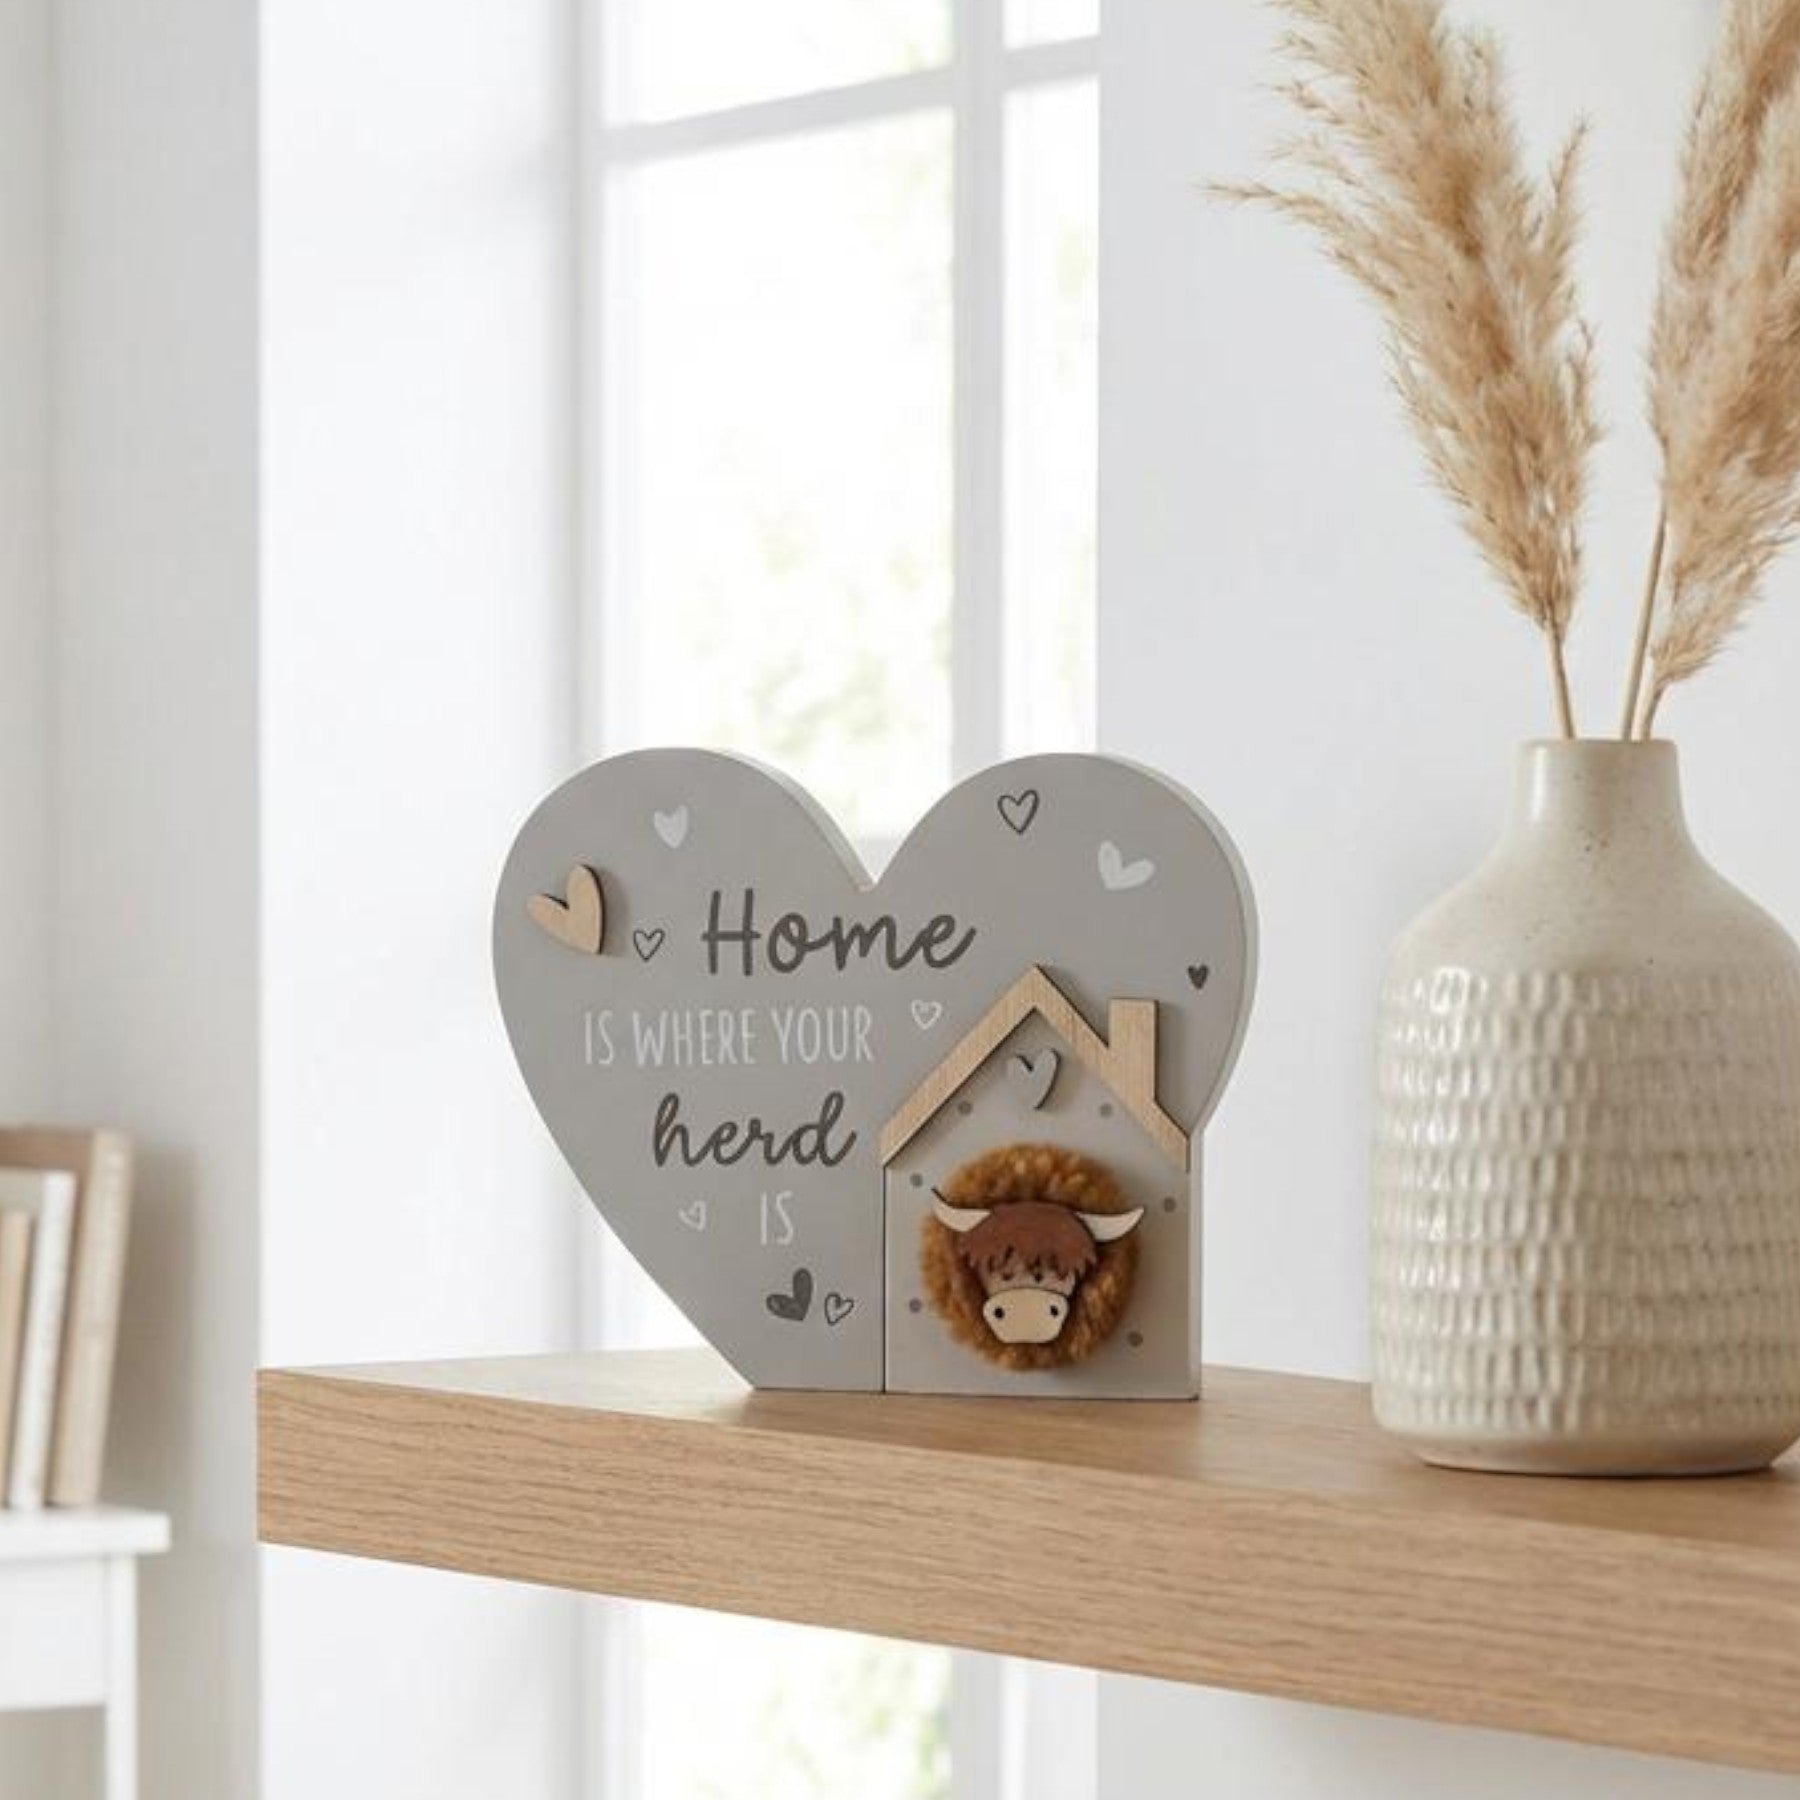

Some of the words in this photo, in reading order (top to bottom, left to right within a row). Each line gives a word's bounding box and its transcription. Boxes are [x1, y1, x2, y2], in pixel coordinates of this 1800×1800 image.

[701, 888, 976, 976] Home
[584, 1010, 615, 1066] IS
[633, 1009, 757, 1066] WHERE
[771, 1006, 874, 1063] YOUR
[652, 1091, 857, 1167] herd
[759, 1190, 794, 1245] IS
